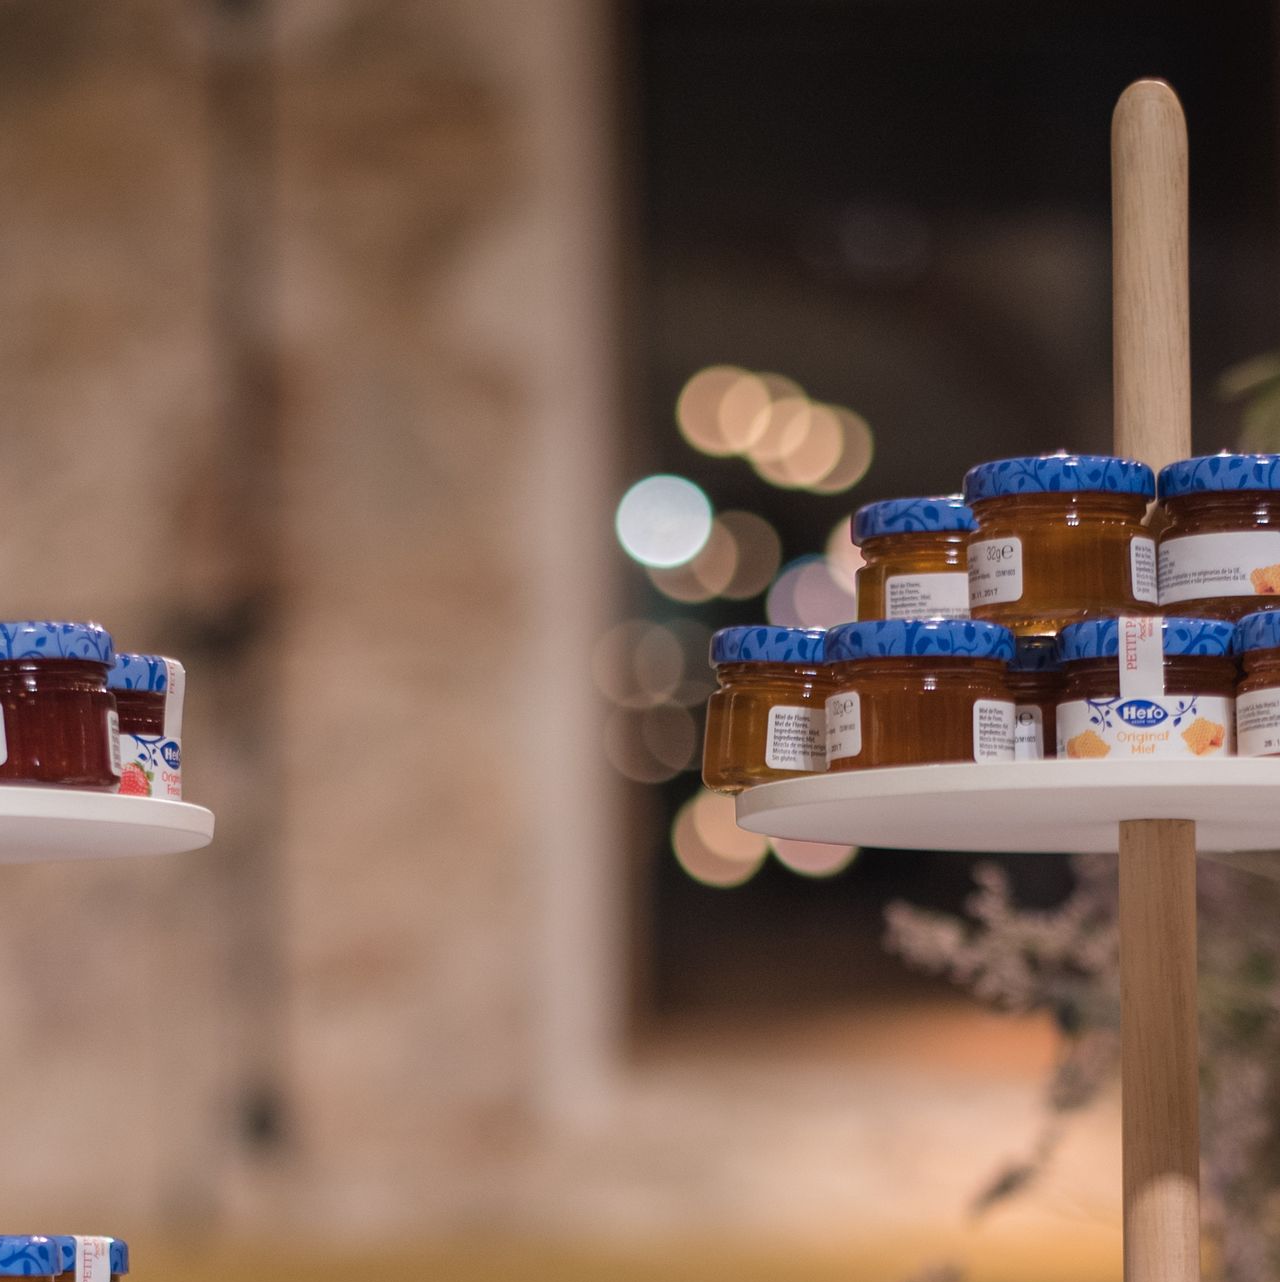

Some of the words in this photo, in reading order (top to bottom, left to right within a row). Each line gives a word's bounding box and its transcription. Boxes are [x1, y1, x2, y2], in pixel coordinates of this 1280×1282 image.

[1126, 634, 1137, 671] PETIT
[1122, 706, 1164, 719] Hero
[1116, 731, 1169, 743] Original
[1132, 744, 1156, 754] Miel
